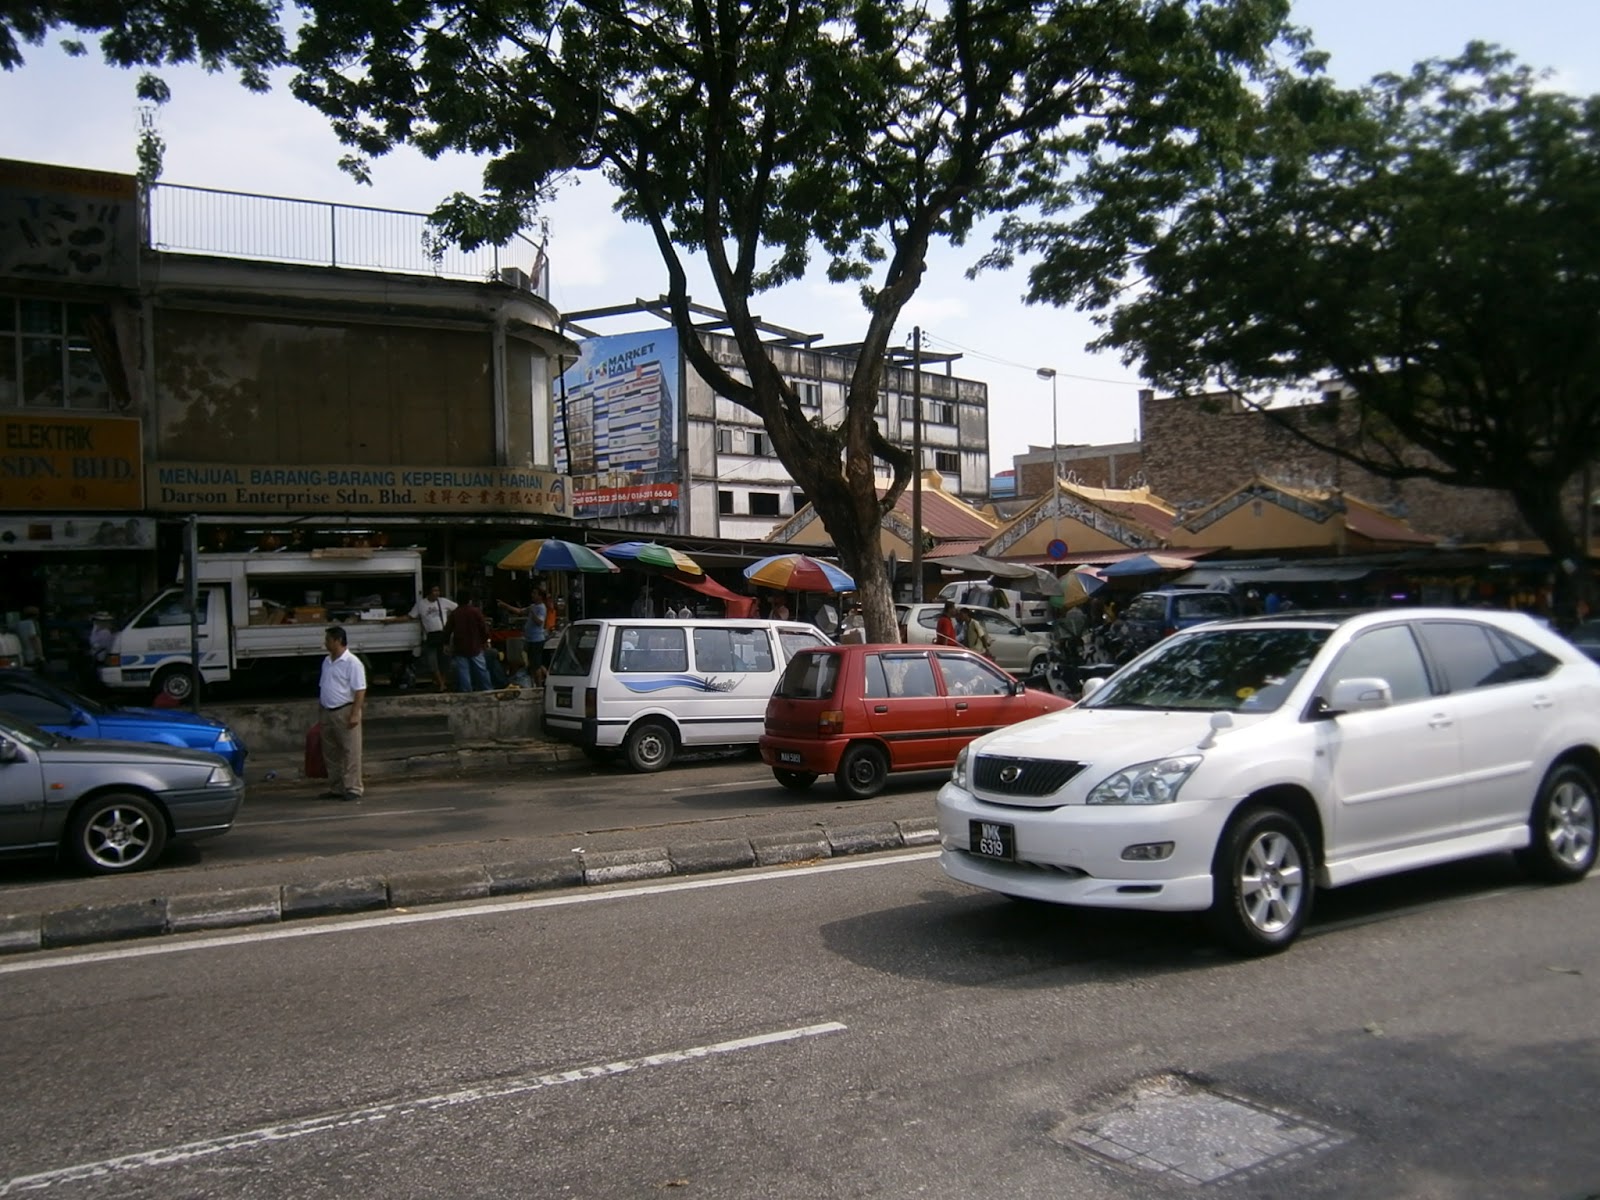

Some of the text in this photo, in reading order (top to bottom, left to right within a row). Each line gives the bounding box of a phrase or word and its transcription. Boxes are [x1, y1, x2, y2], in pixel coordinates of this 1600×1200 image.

[608, 342, 655, 365] MARKET
[608, 360, 635, 376] HALL
[6, 424, 94, 450] ELEKTRIK
[1, 455, 135, 480] SDN. BHD.
[159, 468, 542, 489] MENJUAL BARANG-BARANG KEPERLUAN HARIAN
[160, 487, 417, 509] Darson Enterprise Sdn. Bhd.
[654, 490, 672, 498] 6636
[980, 838, 1003, 856] 6319
